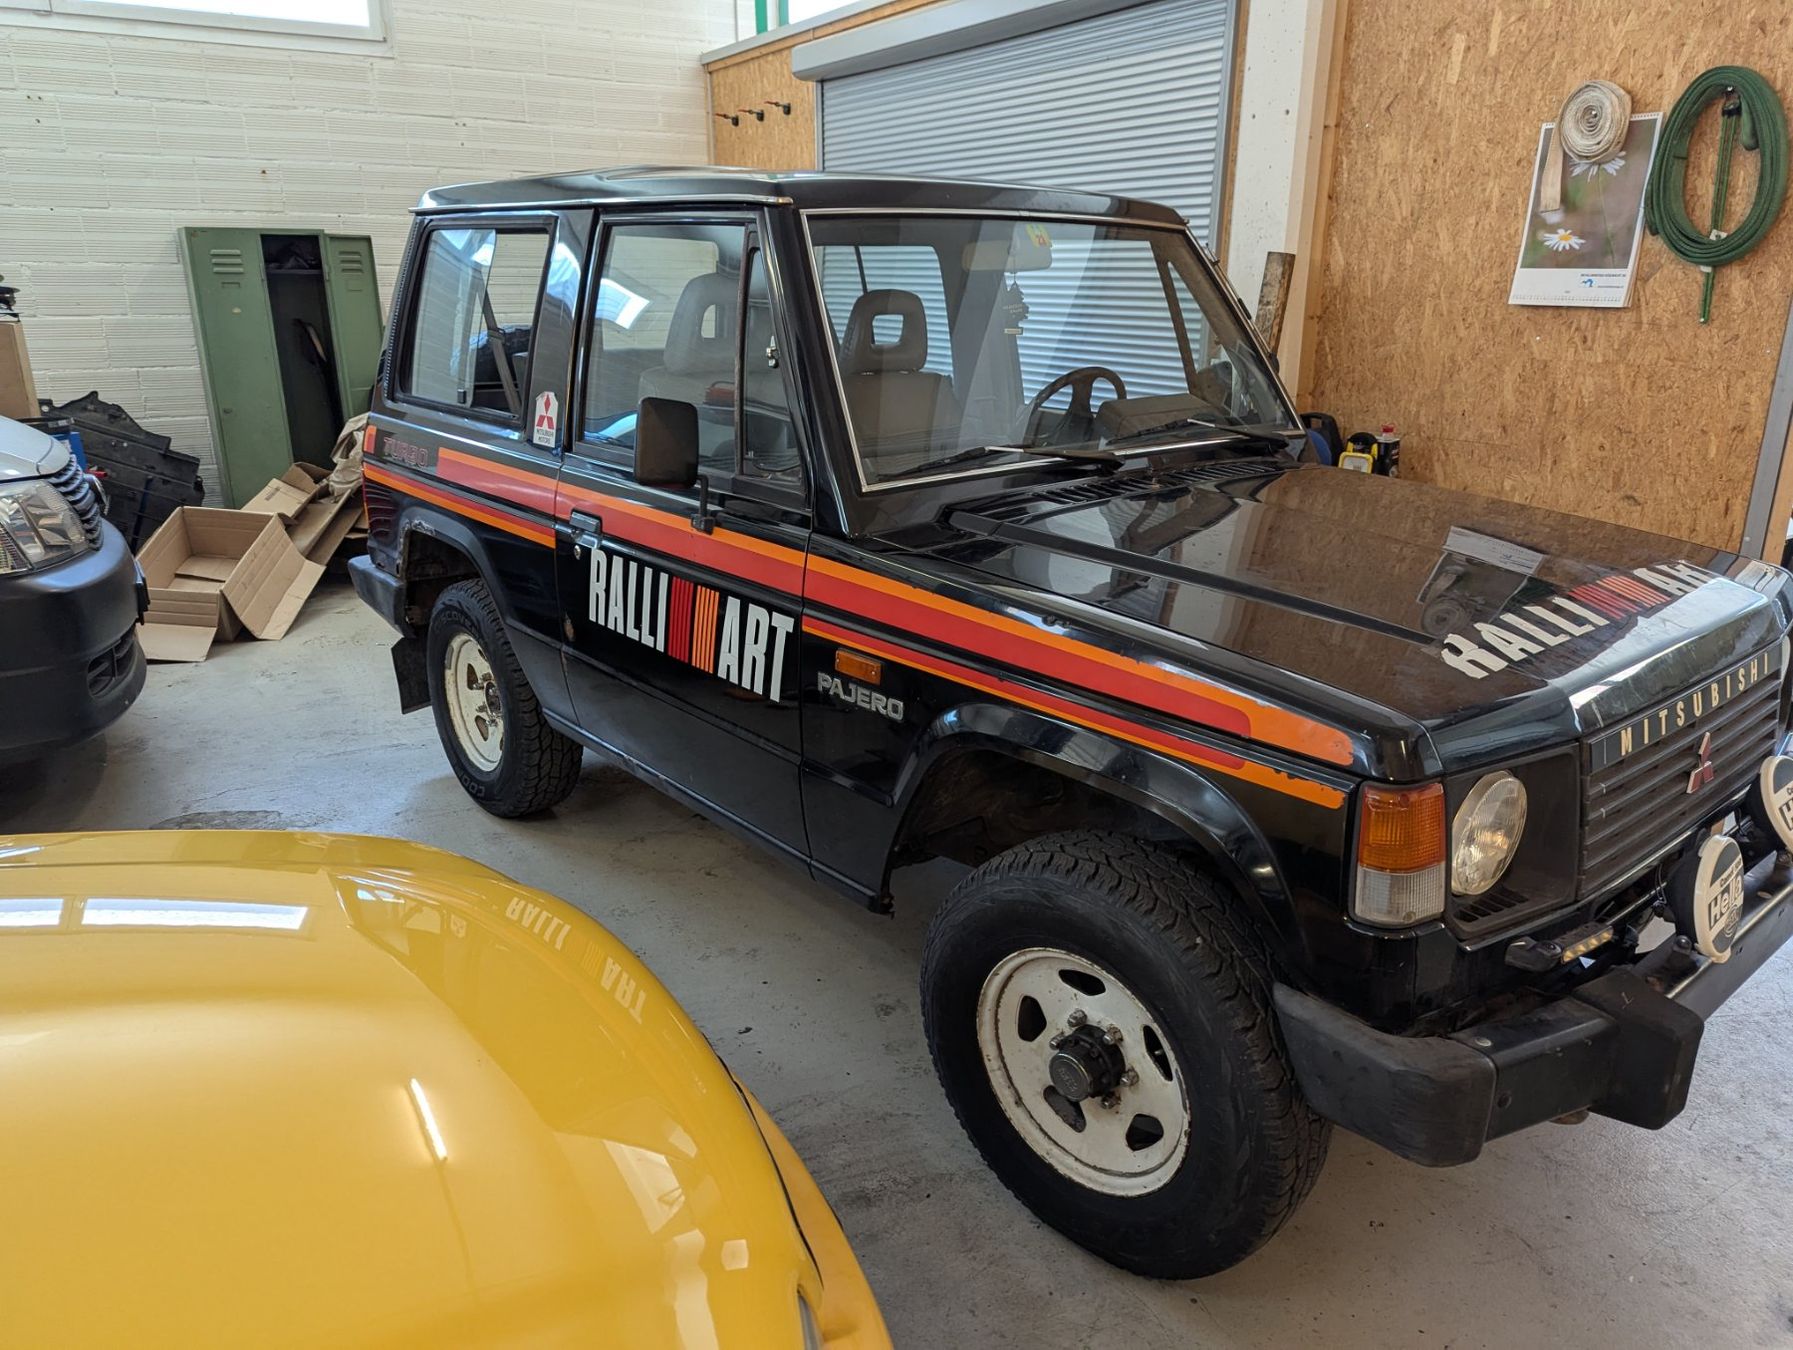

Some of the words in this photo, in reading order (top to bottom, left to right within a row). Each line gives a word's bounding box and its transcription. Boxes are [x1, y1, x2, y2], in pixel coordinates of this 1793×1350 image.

[383, 436, 428, 468] TURBO
[589, 547, 669, 653] RALLI
[717, 595, 795, 703] ART
[1441, 596, 1610, 680] RALLI
[817, 671, 904, 721] PAJERO
[1620, 651, 1768, 756] MITSUBISHI
[1710, 874, 1742, 928] Hella
